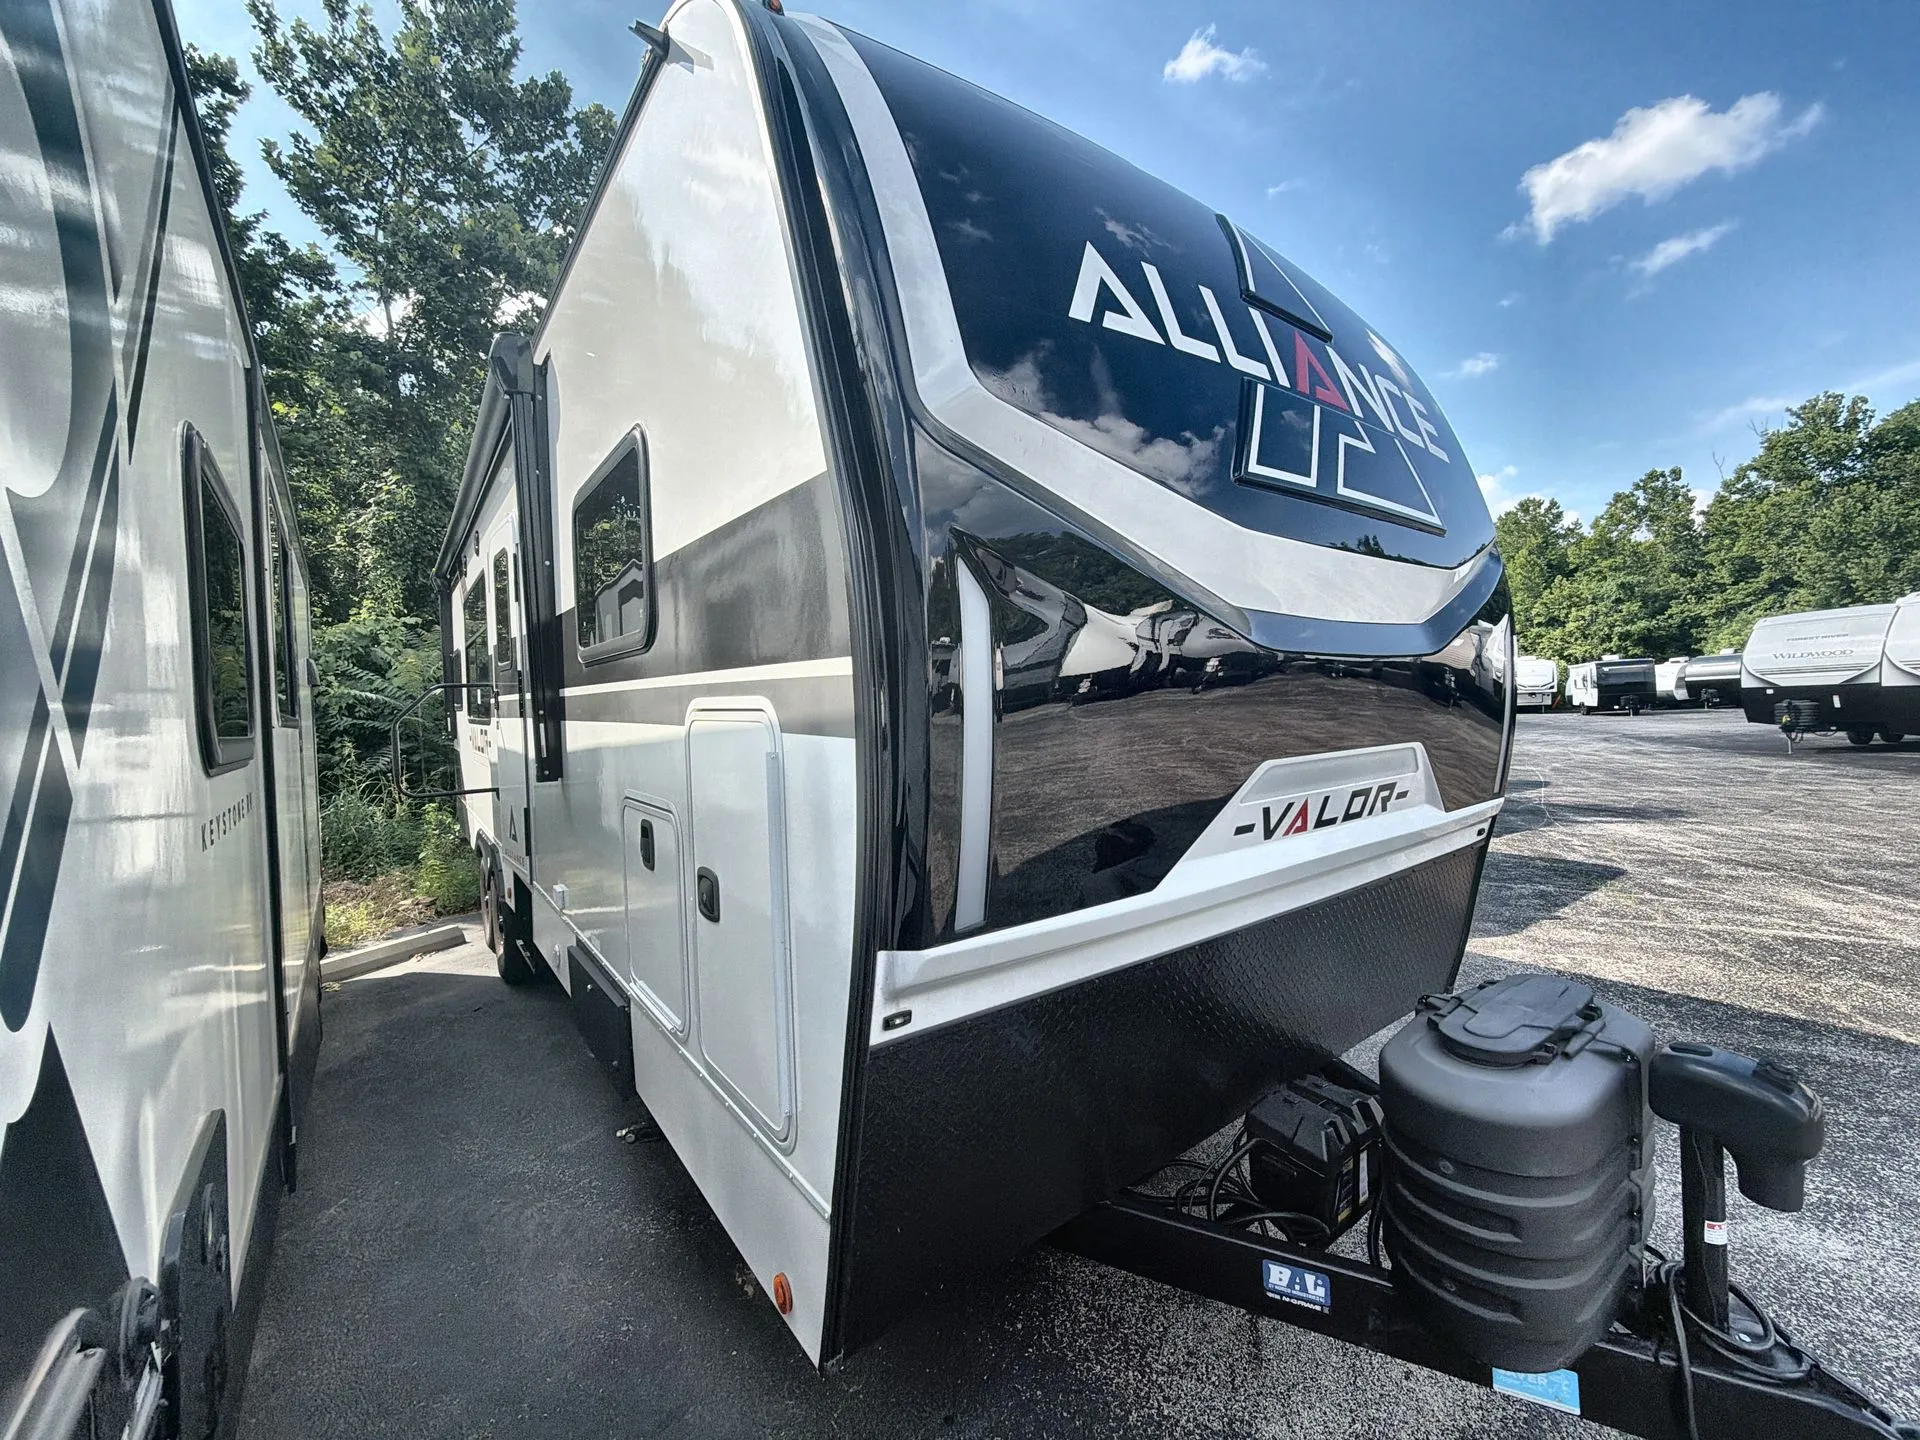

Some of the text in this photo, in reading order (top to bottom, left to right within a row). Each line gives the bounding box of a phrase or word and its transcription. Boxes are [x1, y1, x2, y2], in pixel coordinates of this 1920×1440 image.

[1069, 240, 1450, 463] ALLIANCE
[1772, 649, 1854, 660] WILDWOOD
[201, 798, 245, 852] KEYSTONE
